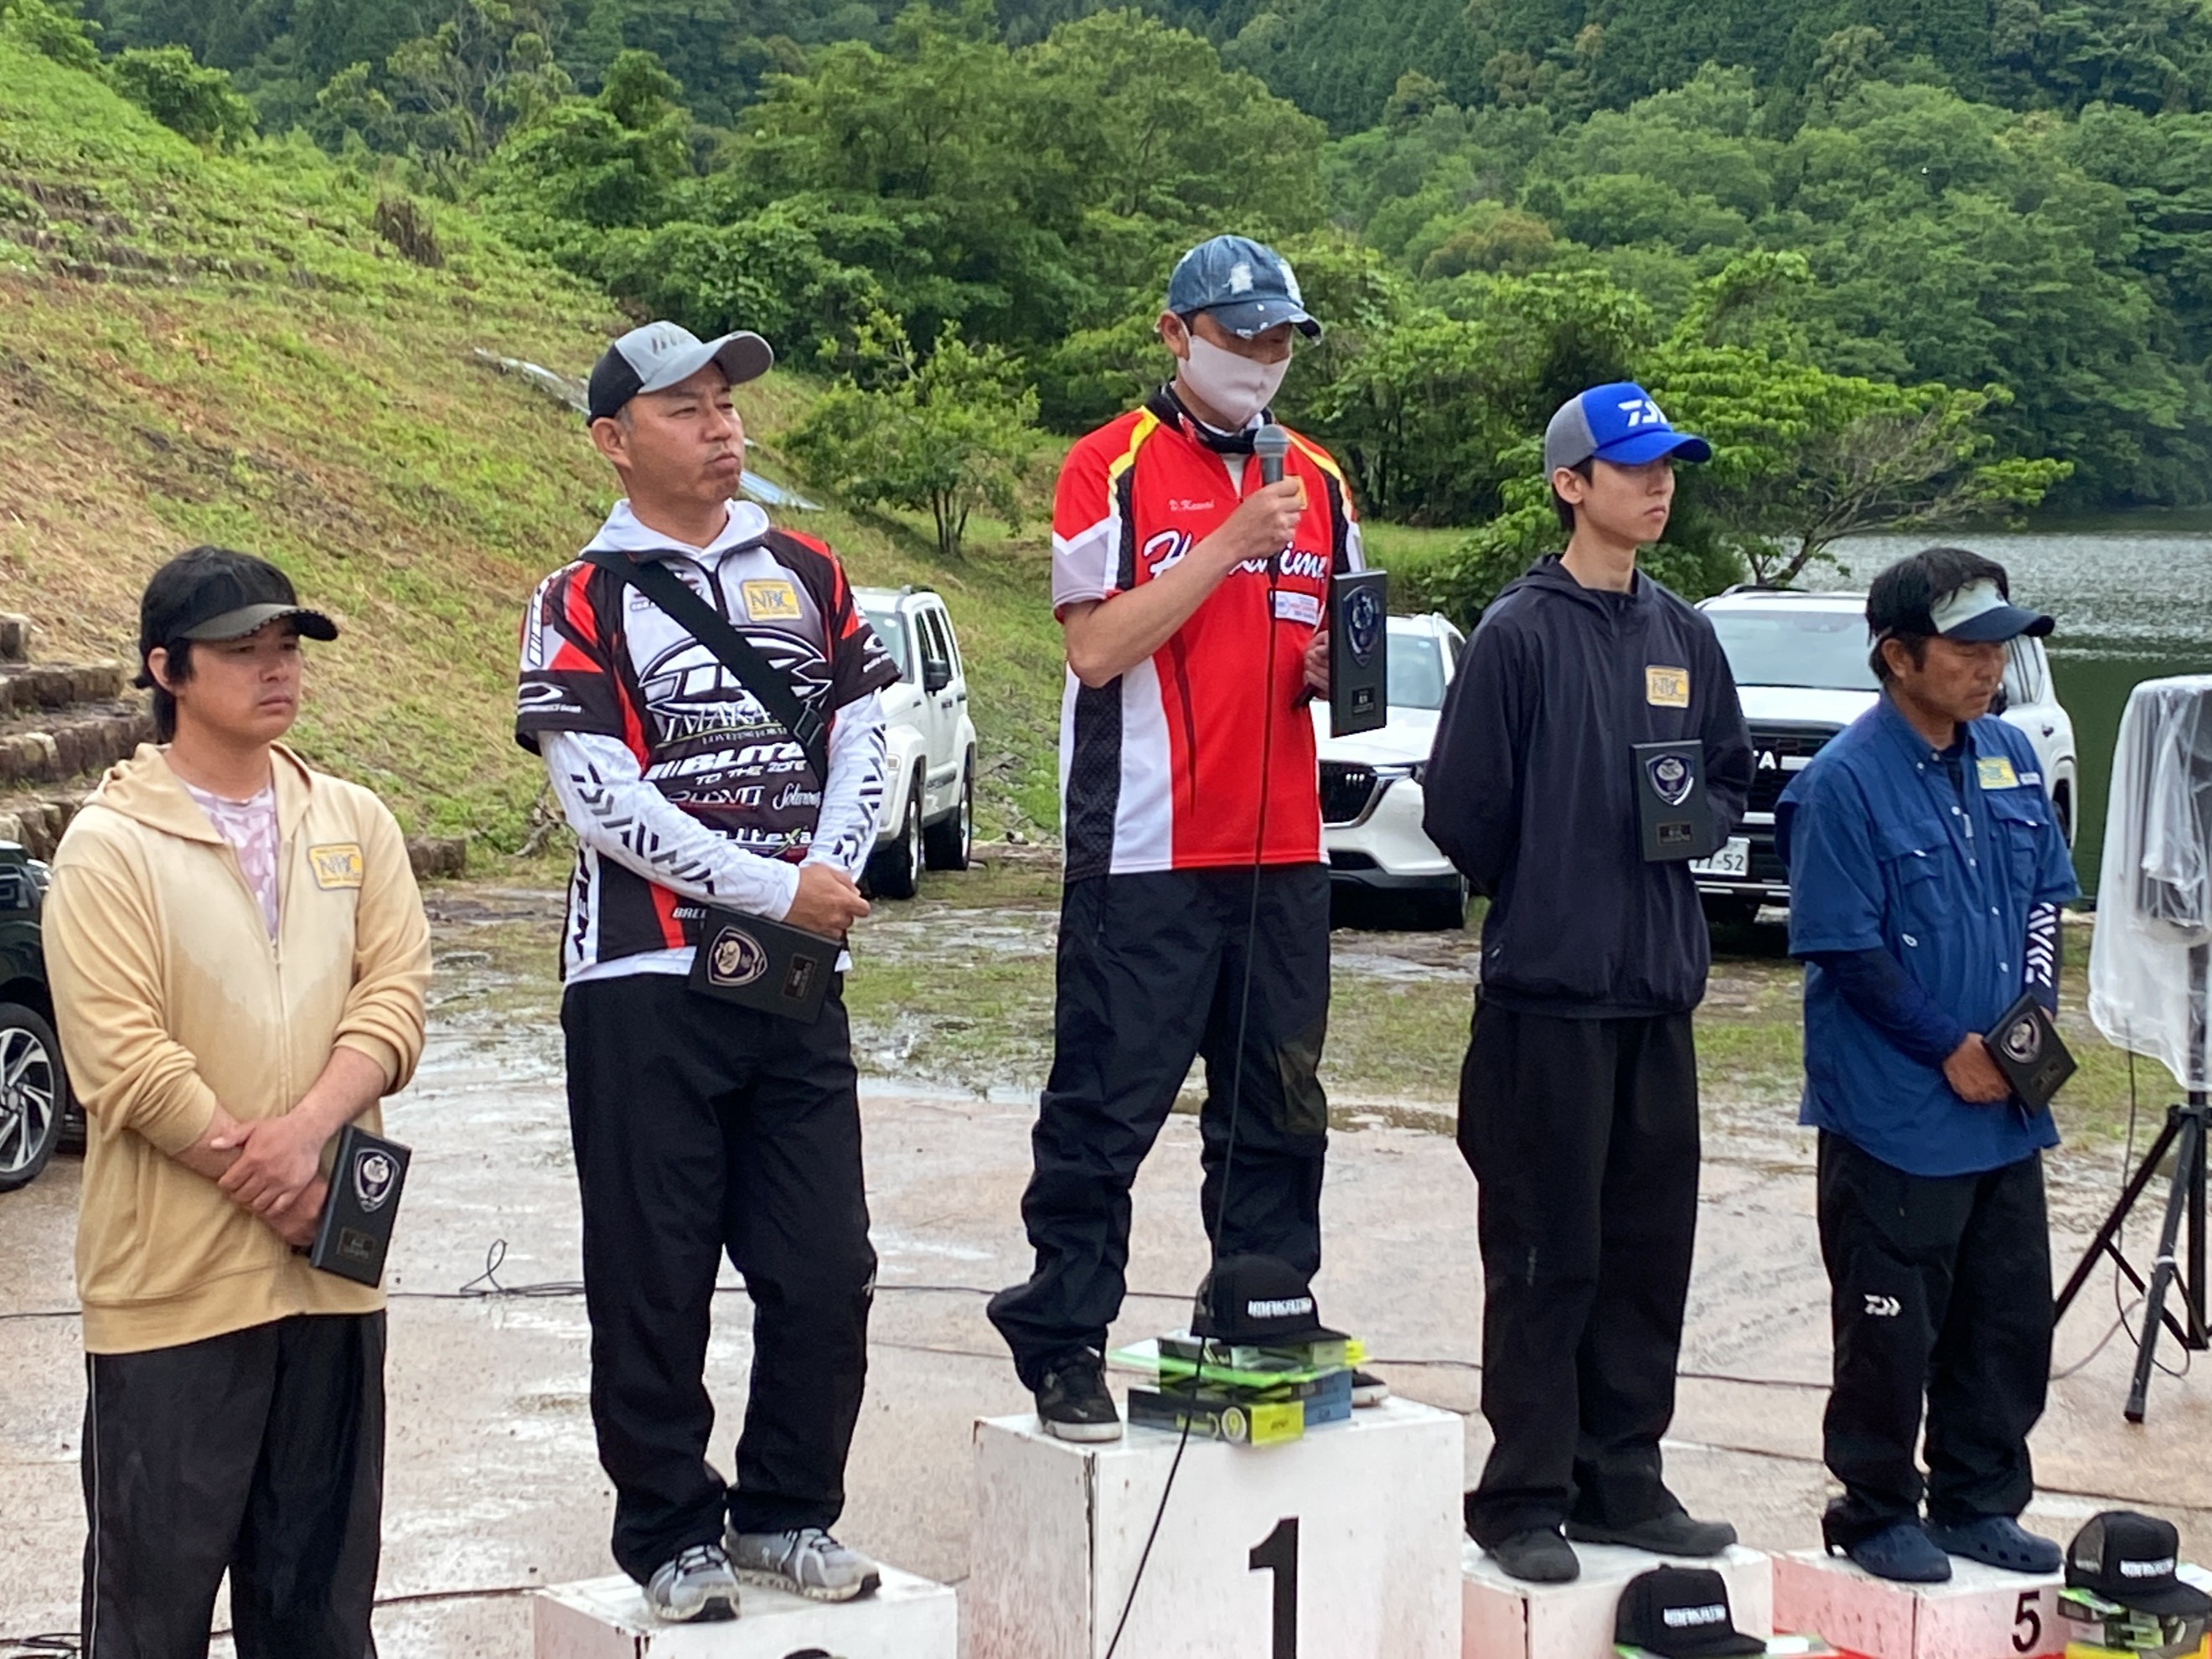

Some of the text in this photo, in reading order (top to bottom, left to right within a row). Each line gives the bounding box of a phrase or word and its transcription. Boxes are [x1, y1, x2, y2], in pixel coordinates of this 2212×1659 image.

[675, 742, 805, 776] BLITZ
[695, 772, 721, 785] TO
[726, 765, 763, 778] THE
[1249, 1517, 1299, 1659] 1
[2013, 1590, 2040, 1651] 5
